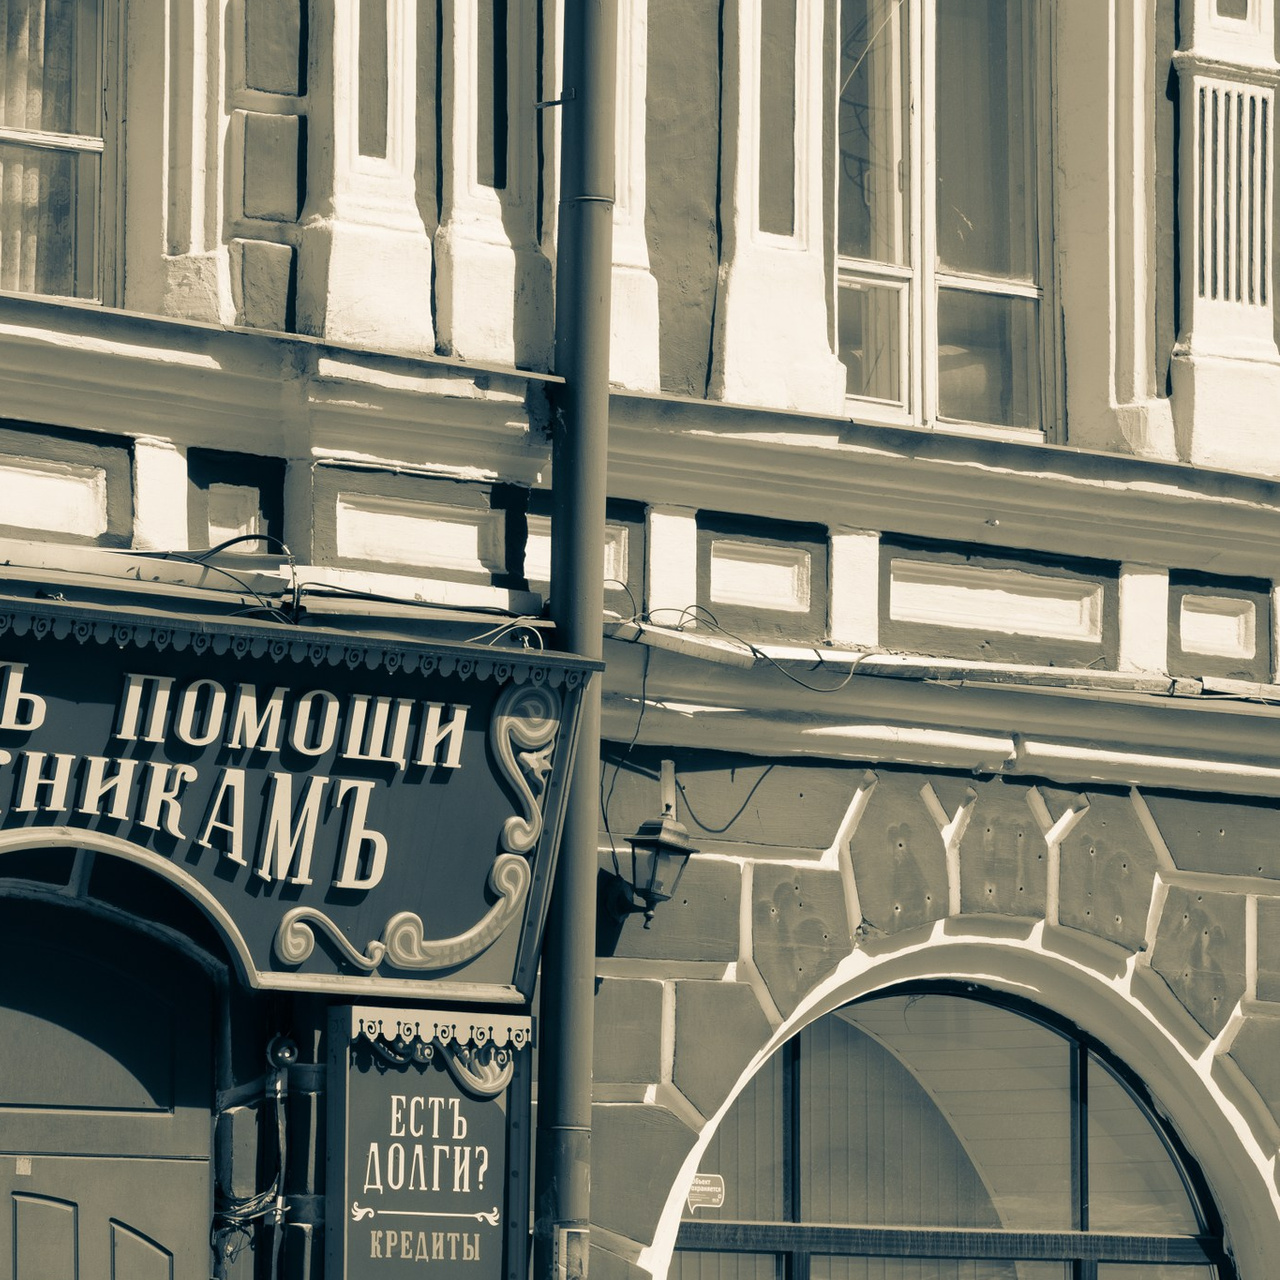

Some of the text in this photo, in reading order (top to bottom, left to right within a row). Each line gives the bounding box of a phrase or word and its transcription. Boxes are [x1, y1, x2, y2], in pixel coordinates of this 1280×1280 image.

[112, 673, 471, 771] ПОМОЩИ
[390, 1095, 468, 1140] ЕСТЪ
[363, 1142, 489, 1195] ДОЛГИ?
[370, 1230, 481, 1263] КРЕДИТЫ
